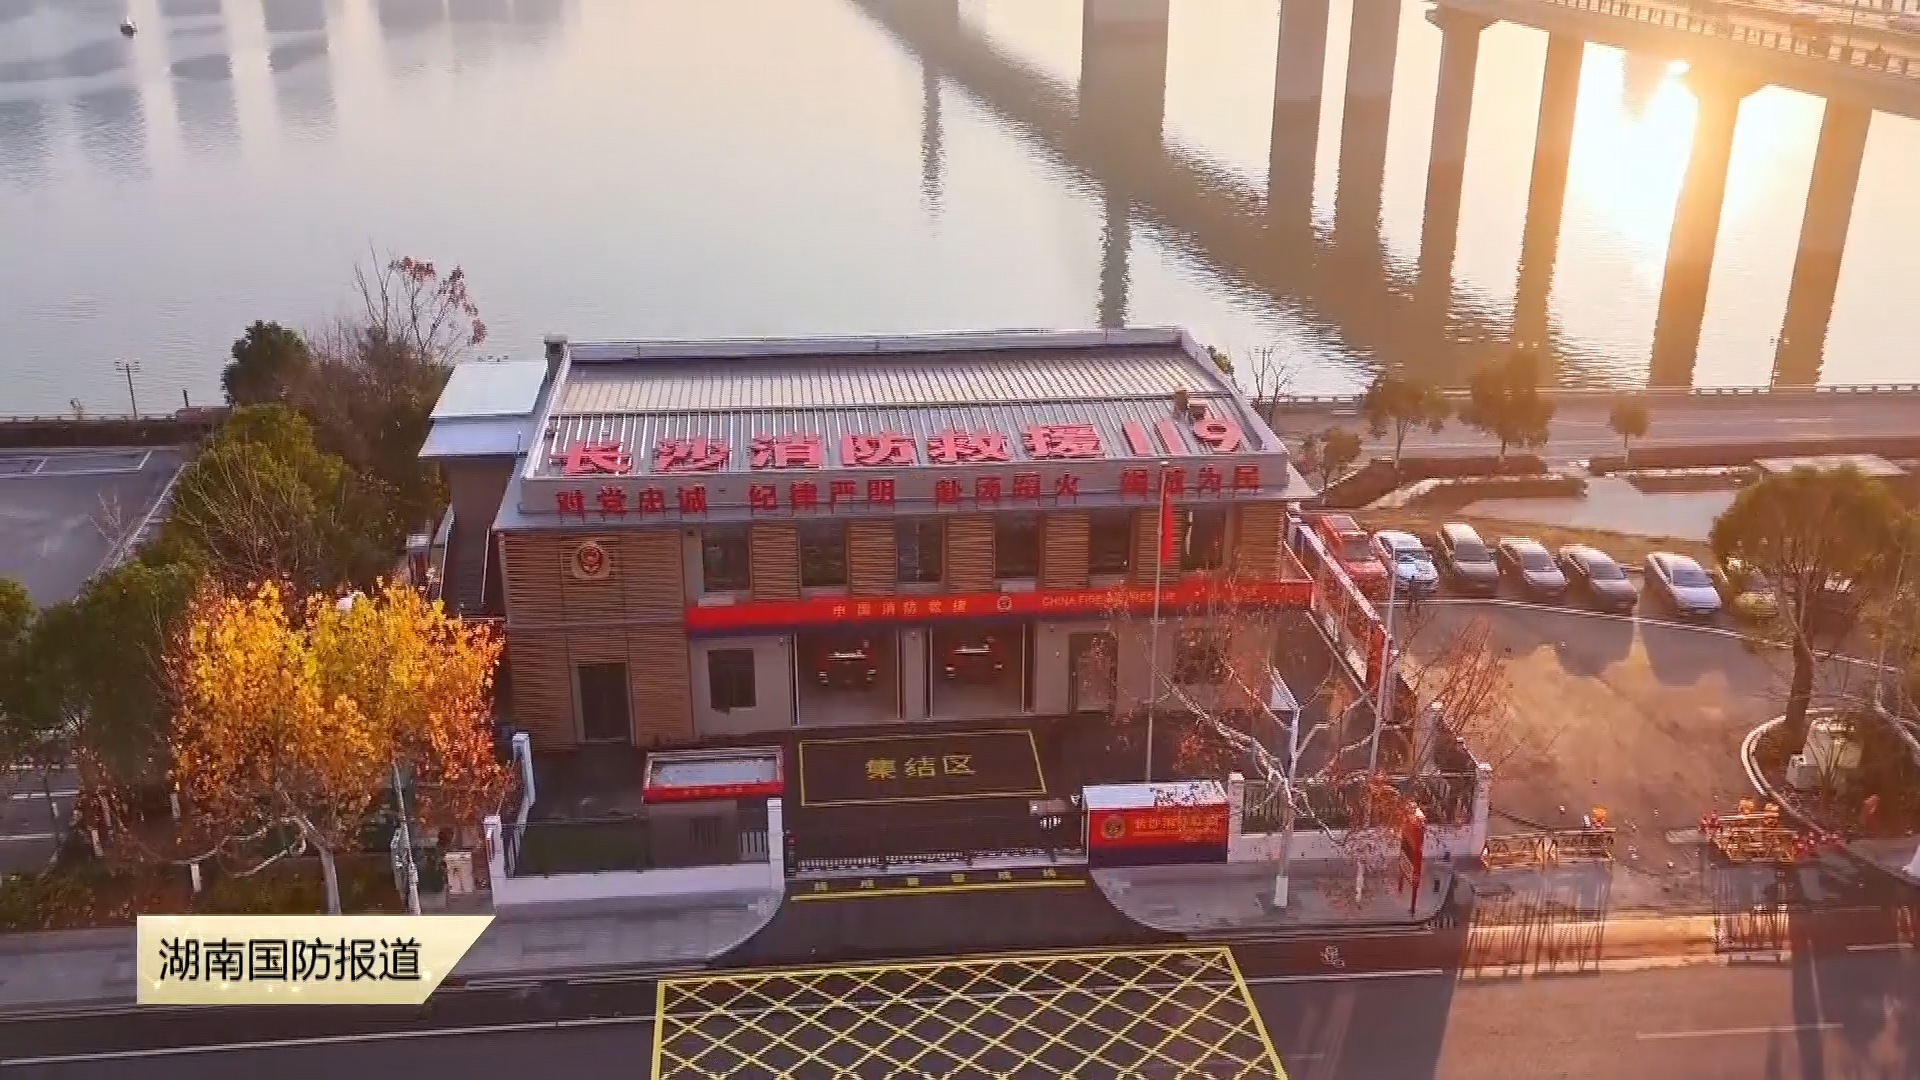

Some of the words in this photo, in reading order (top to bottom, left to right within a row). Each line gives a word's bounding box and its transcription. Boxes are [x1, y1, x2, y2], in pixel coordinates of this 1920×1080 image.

[556, 481, 706, 513] 对党忠诚
[750, 477, 895, 510] 纪律严明
[833, 599, 966, 617] 中国消防救援
[865, 754, 977, 781] 集结区
